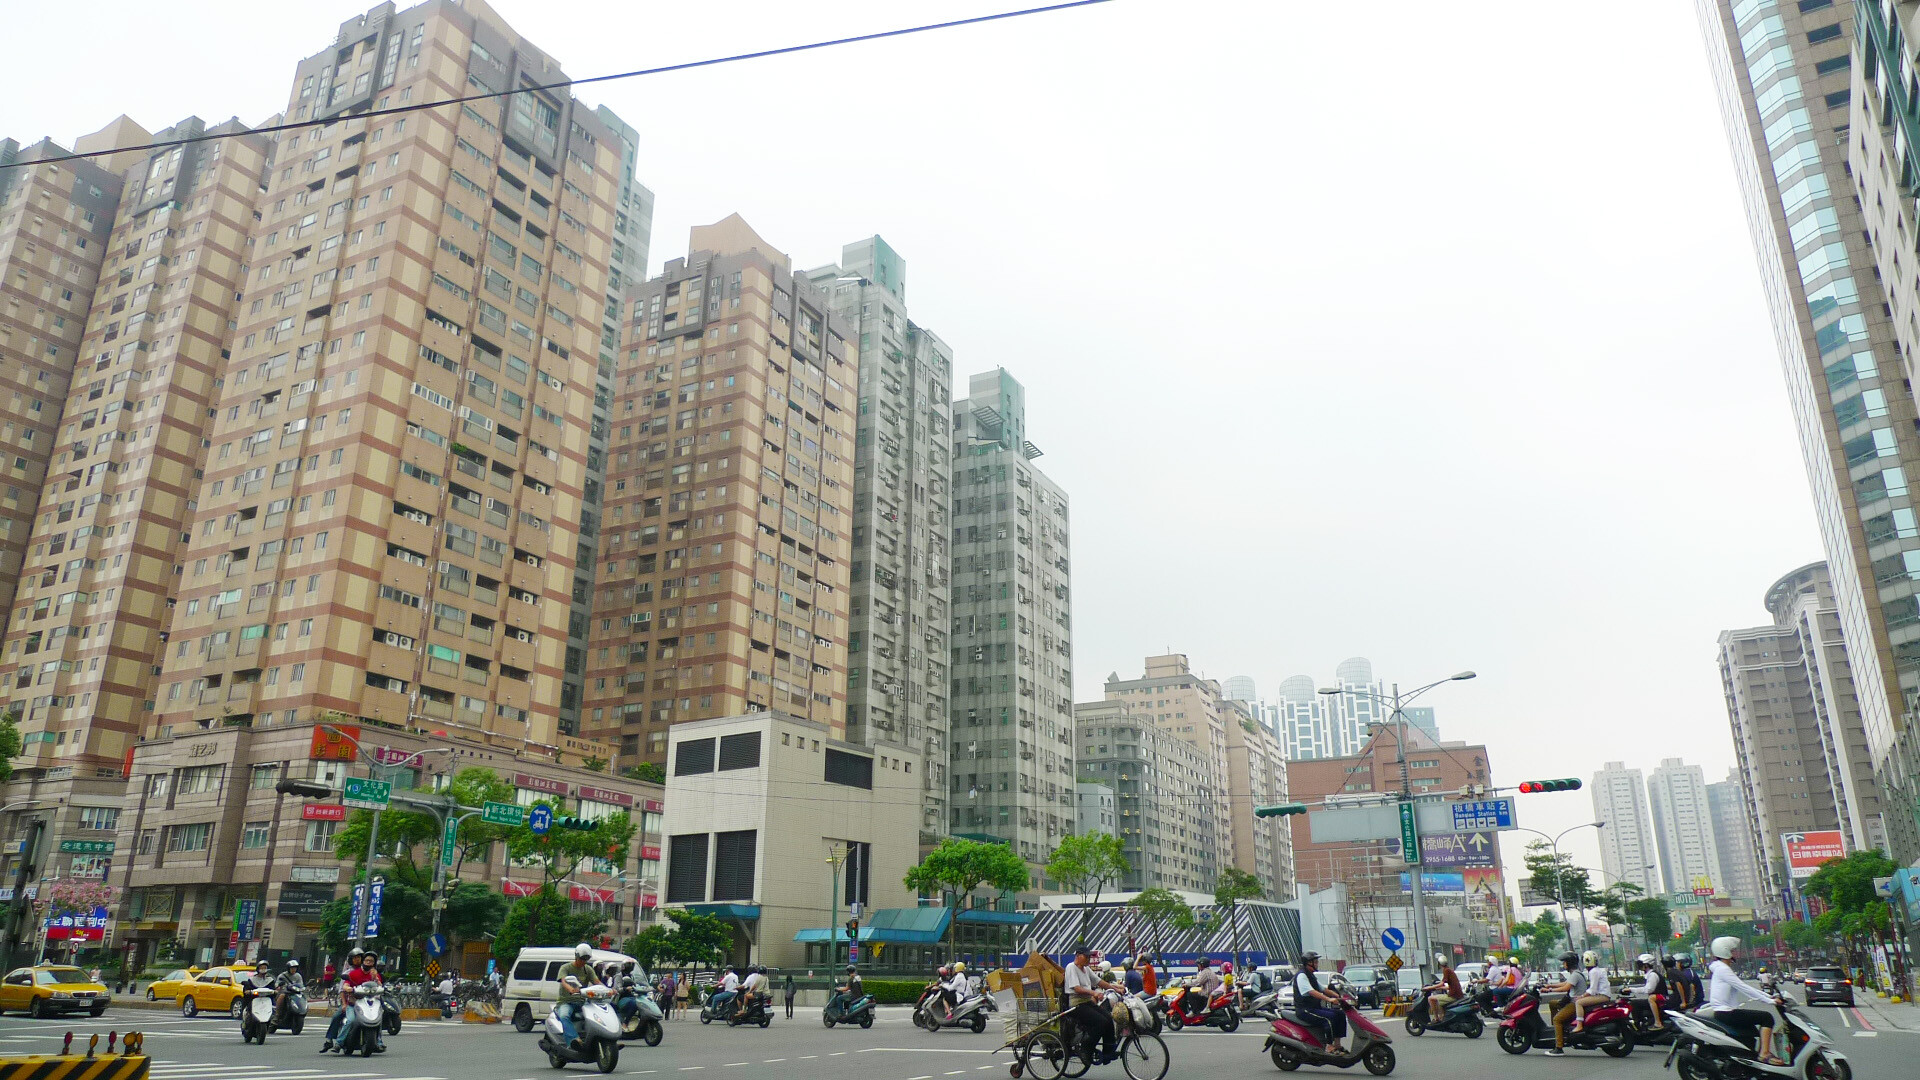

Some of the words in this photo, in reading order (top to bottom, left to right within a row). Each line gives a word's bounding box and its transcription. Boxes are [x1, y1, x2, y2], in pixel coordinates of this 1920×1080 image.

[362, 781, 384, 790] 文化路
[1454, 801, 1496, 812] 板橋車站
[1499, 801, 1507, 810] 2
